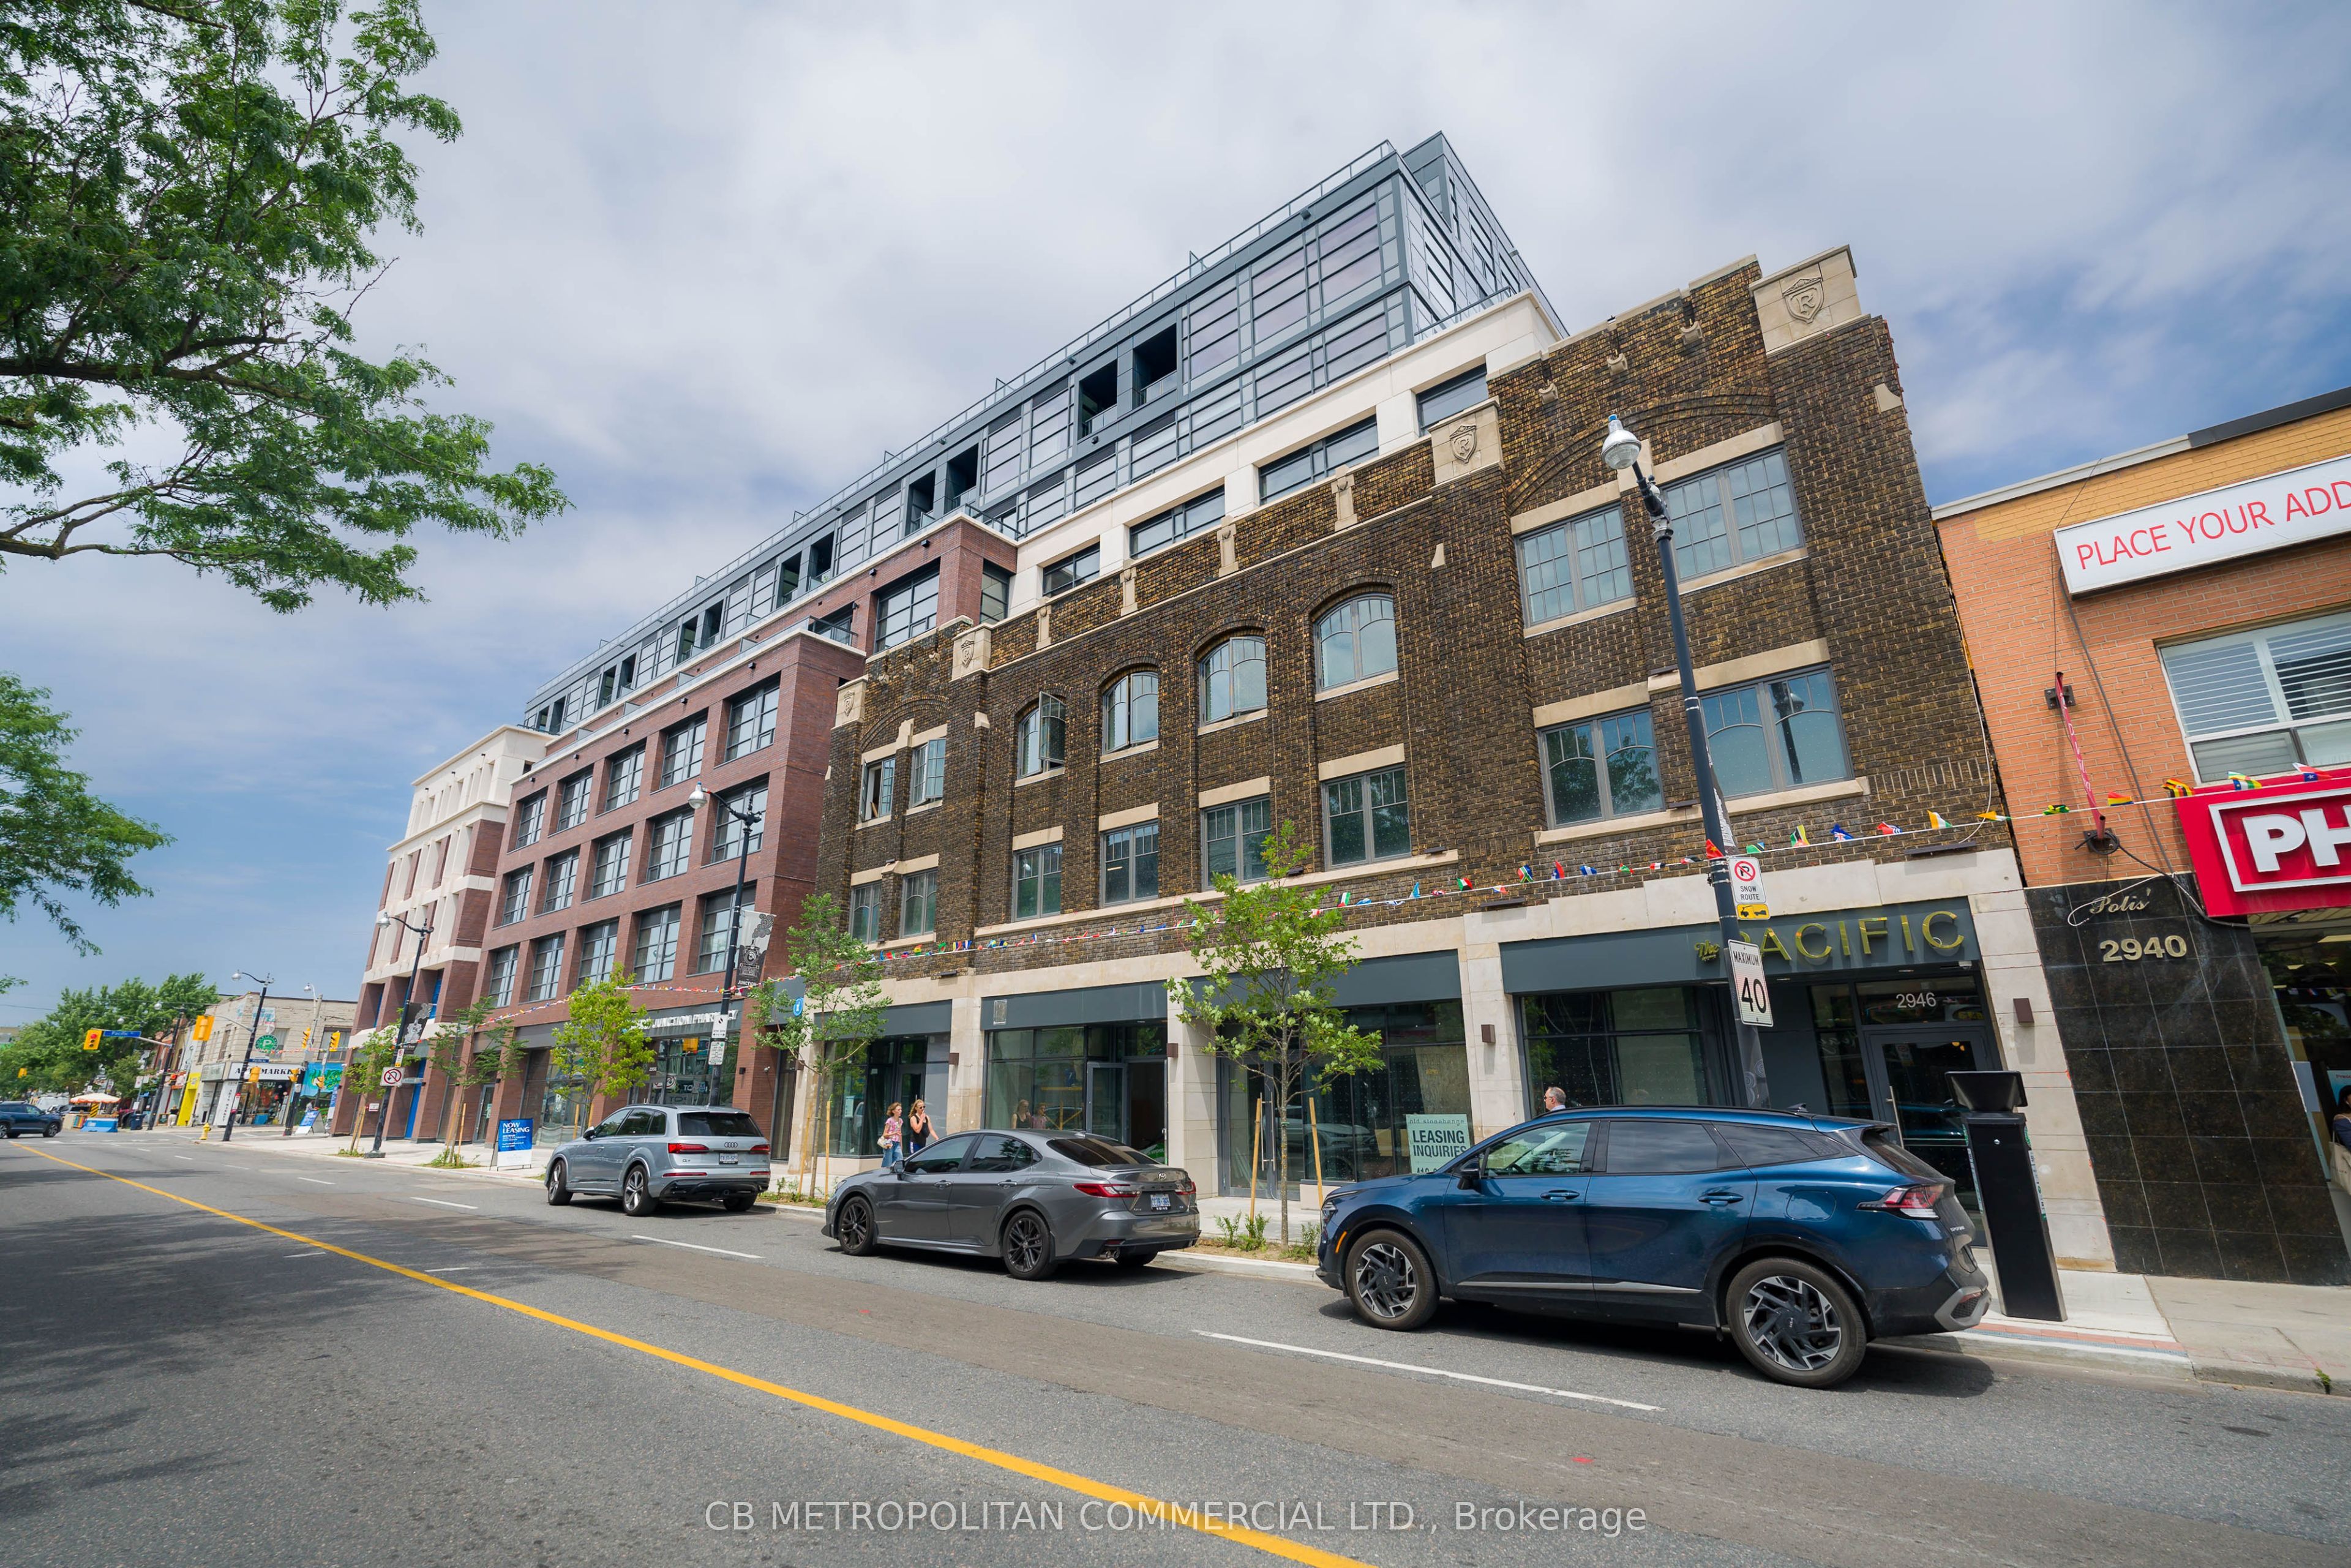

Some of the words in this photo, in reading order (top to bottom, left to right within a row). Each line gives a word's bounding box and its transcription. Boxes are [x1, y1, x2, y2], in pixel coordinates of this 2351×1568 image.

[2076, 525, 2172, 570] PLACE
[2177, 501, 2276, 544] YOUR
[2286, 481, 2351, 522] ADD
[2099, 935, 2187, 962] 2940
[1733, 950, 1760, 966] MAXIMUM
[1741, 977, 1766, 1013] 40
[1896, 992, 1937, 1008] 2946
[652, 1015, 692, 1028] JUNCTION
[263, 1039, 272, 1048] P
[1412, 1130, 1465, 1144] LEASING
